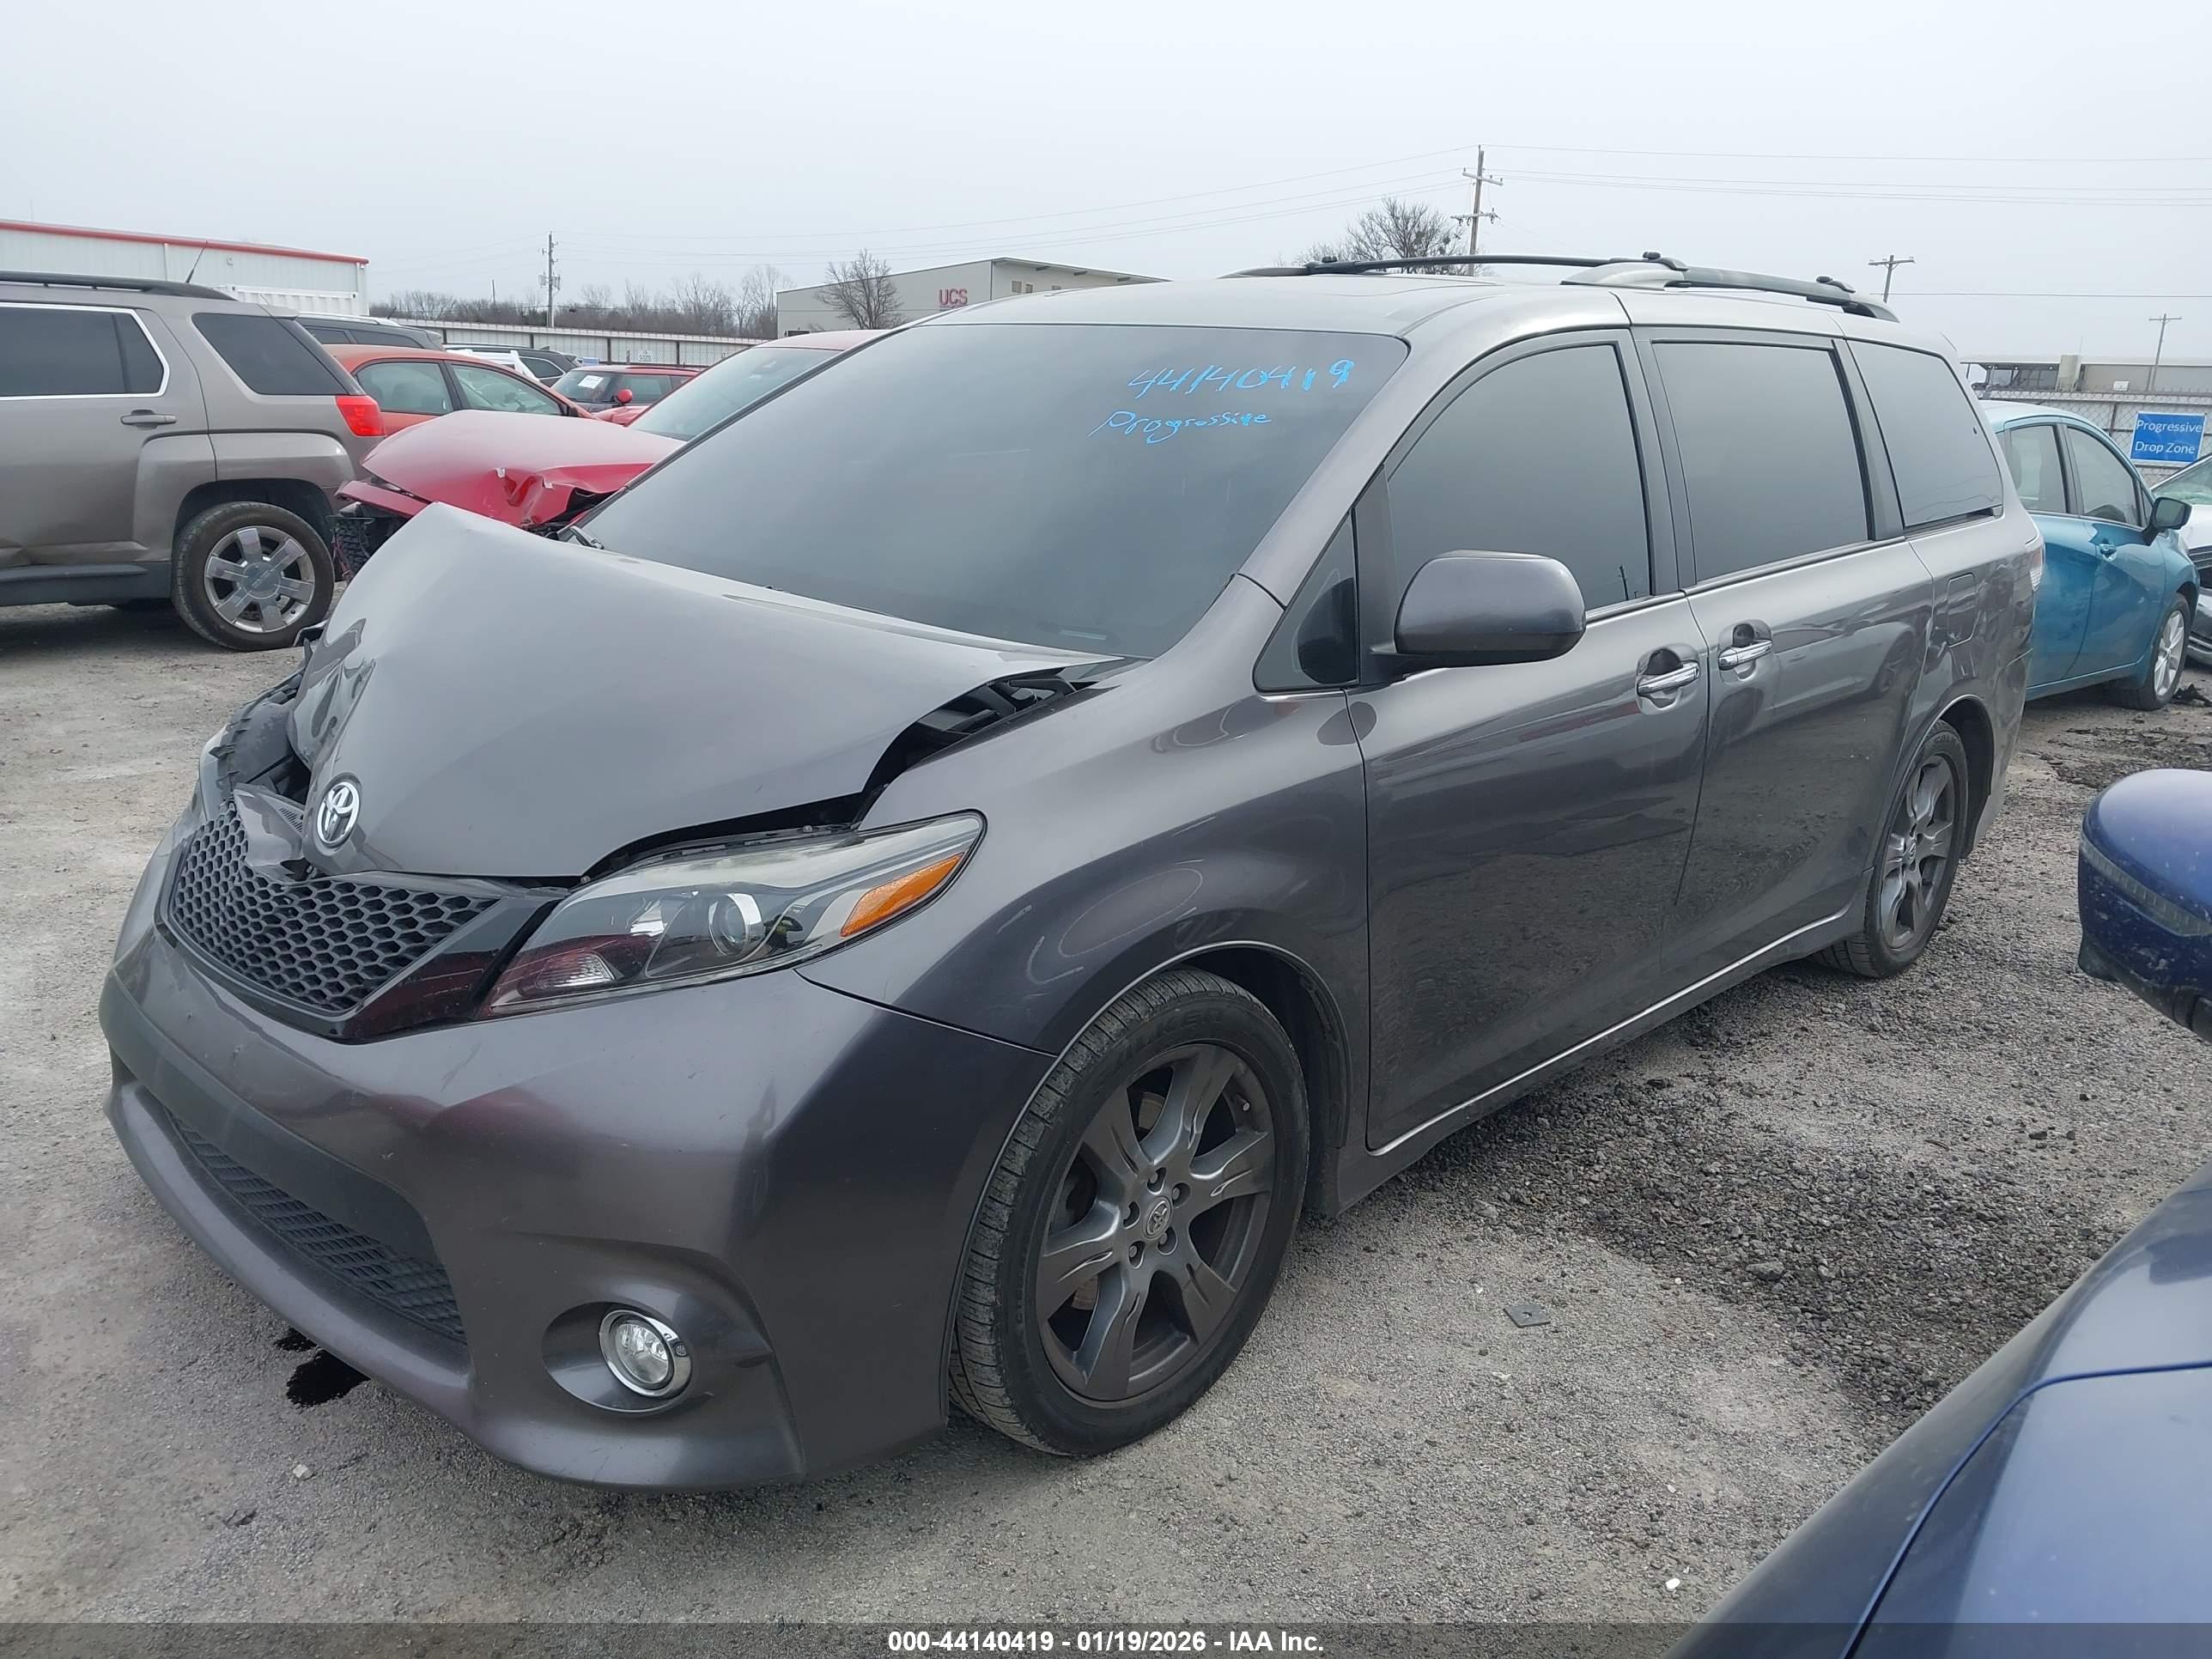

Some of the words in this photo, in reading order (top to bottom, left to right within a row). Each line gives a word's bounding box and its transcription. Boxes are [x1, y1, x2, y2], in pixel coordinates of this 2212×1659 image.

[939, 288, 968, 306] UCS
[2136, 419, 2203, 433] Progressive
[2135, 441, 2164, 454] Drop
[2166, 442, 2196, 454] Zone
